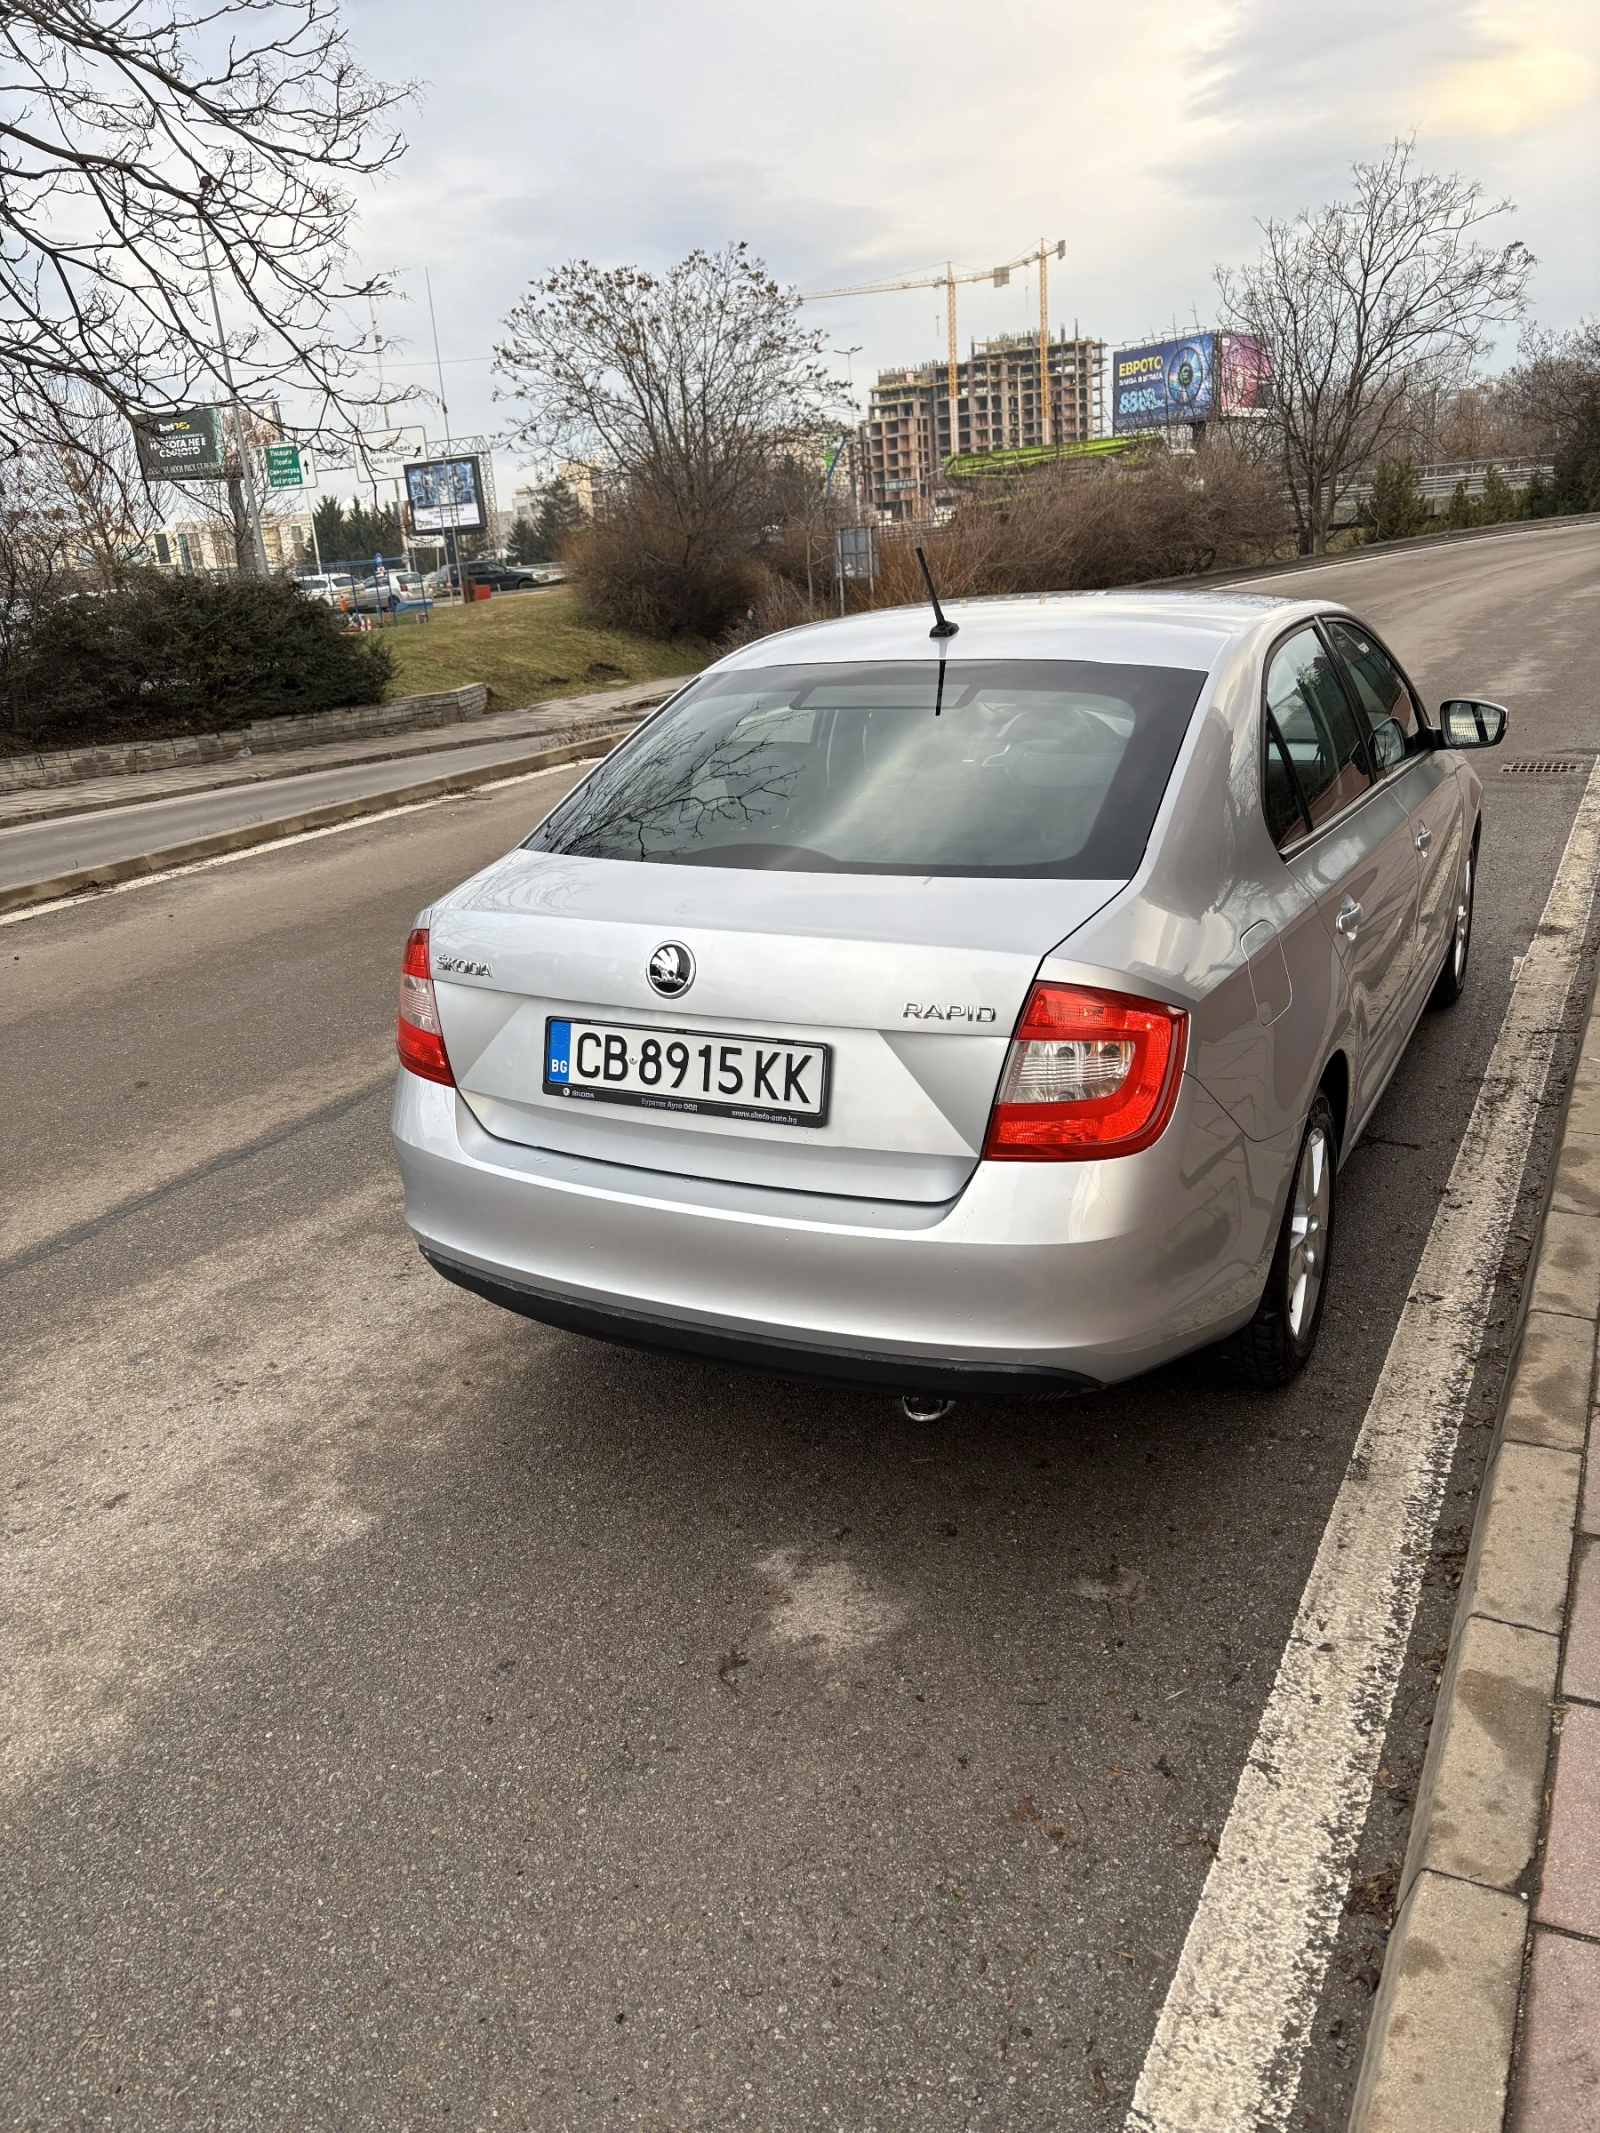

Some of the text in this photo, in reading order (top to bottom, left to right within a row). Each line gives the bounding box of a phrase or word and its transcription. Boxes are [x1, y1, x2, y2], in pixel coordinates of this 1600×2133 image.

[1118, 356, 1164, 377] ЕВРОТО
[188, 437, 201, 447] НЕ
[201, 437, 207, 446] Е
[386, 455, 405, 464] airport
[436, 953, 495, 979] ŠKODA
[902, 1001, 997, 1023] RAPID
[551, 1058, 568, 1074] BG
[637, 1038, 743, 1095] 8915
[753, 1049, 813, 1104] KK
[667, 1100, 683, 1110] Ауто
[683, 1103, 698, 1112] ООД
[731, 1109, 798, 1125] www.skoda-auto.bg
